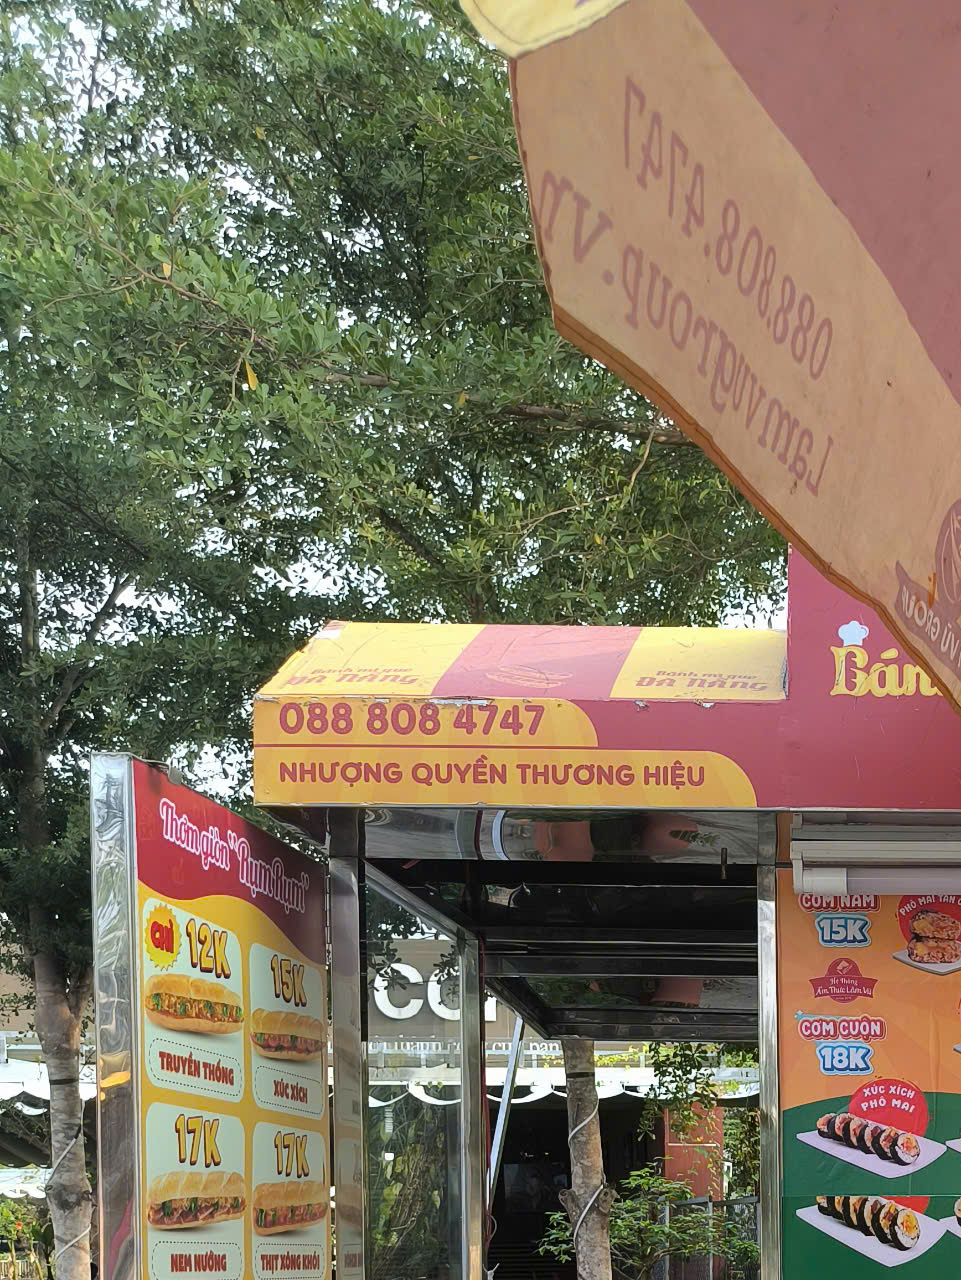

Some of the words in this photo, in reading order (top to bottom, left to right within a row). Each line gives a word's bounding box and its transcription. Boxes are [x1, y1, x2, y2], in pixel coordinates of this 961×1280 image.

[830, 645, 943, 697] Bán
[279, 703, 354, 736] 088
[367, 703, 440, 735] 808
[453, 704, 544, 736] 4747
[279, 760, 403, 787] NHƯỢNG
[411, 755, 507, 784] QUYỀN
[517, 763, 635, 787] THƯƠNG
[643, 760, 705, 789] HIỆU
[160, 798, 200, 855] Thơm
[900, 899, 917, 916] PHÔ
[918, 895, 936, 906] MAI
[818, 918, 868, 943] 15K
[186, 918, 231, 979] 12K
[271, 954, 307, 1007] 15K
[801, 1019, 835, 1036] CƠM
[839, 1016, 881, 1041] CUỘN
[818, 1046, 869, 1070] 18K
[202, 1059, 234, 1085] THỐNG
[273, 1078, 289, 1099] XÚC
[290, 1081, 307, 1104] XÍCH
[863, 1084, 885, 1097] XÚC
[889, 1084, 915, 1099] XÍCH
[861, 1097, 886, 1112] PHÔ
[892, 1098, 915, 1113] MAI
[175, 1113, 222, 1168] 17K
[274, 1131, 309, 1178] 17K
[171, 1254, 192, 1272] NEM
[261, 1254, 279, 1274] THỊT
[280, 1251, 300, 1270] XÔNG
[303, 1251, 319, 1270] KHÓI
